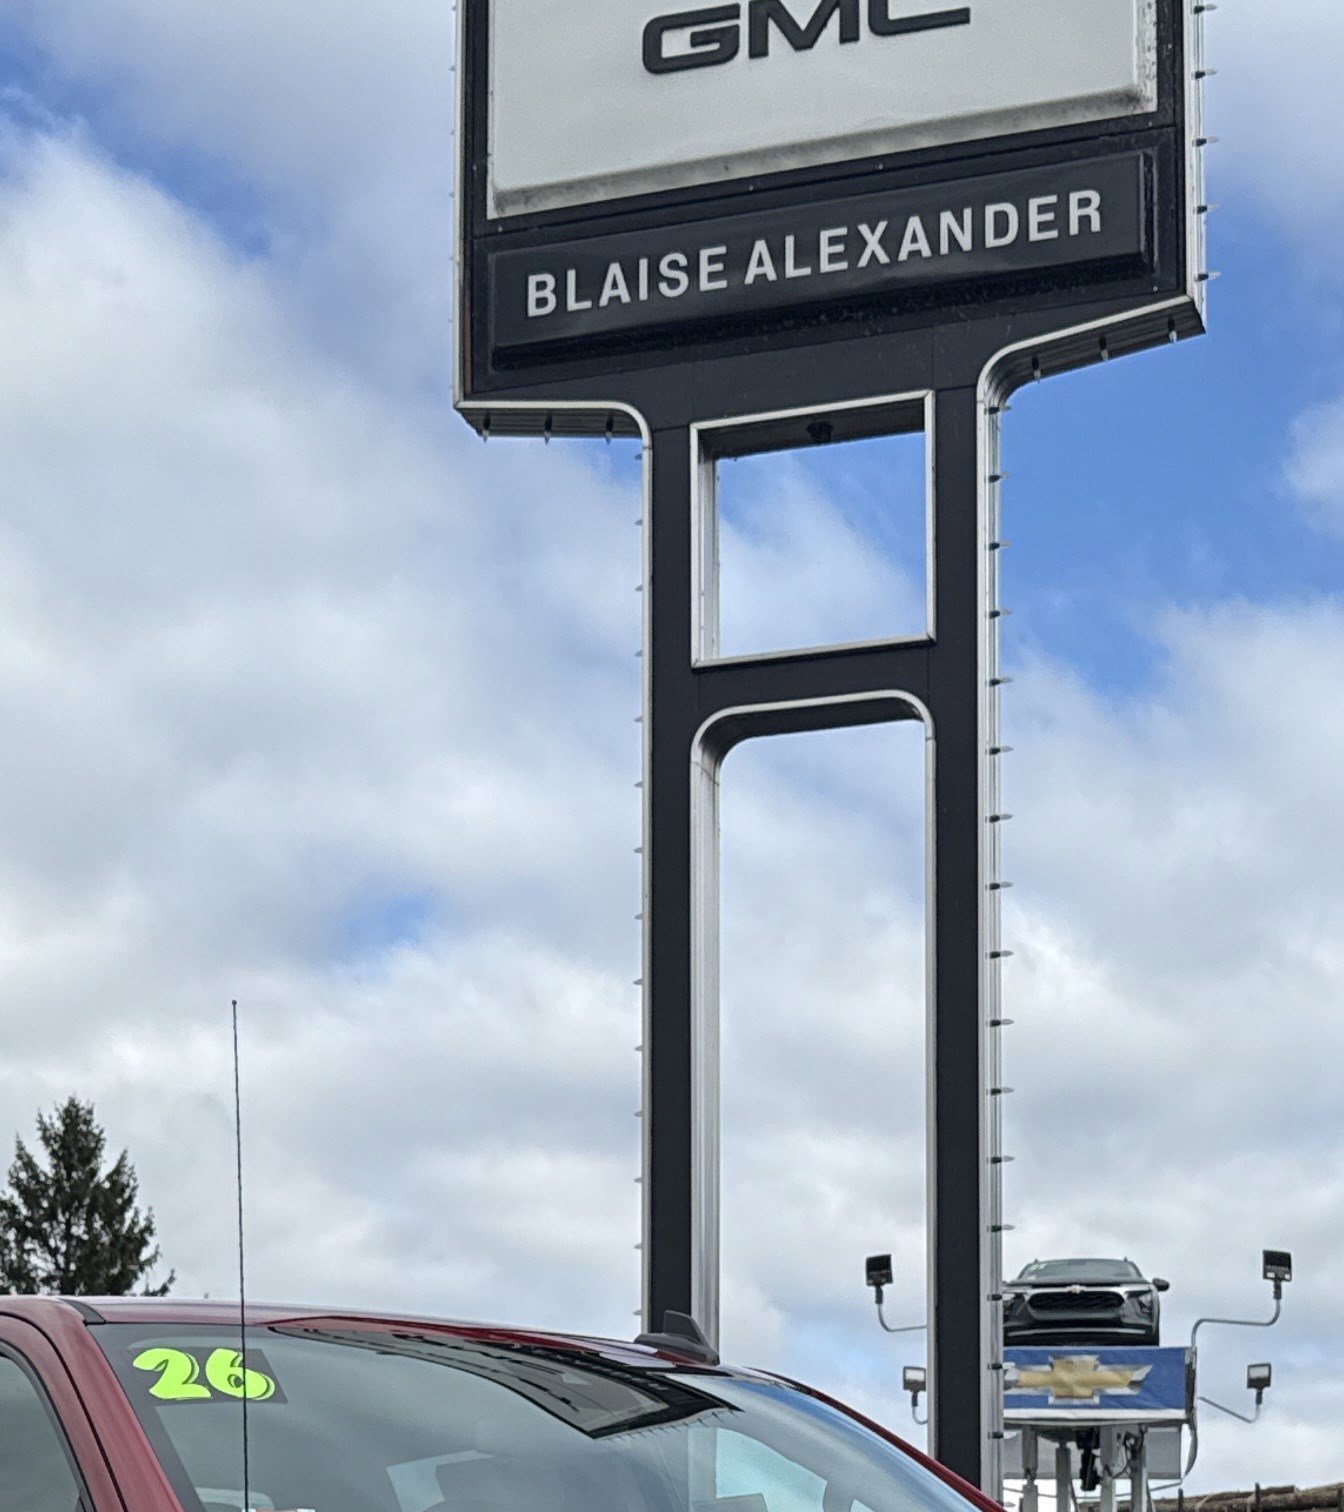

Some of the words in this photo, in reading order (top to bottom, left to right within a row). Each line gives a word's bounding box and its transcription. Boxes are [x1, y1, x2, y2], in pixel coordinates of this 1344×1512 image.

[525, 245, 729, 319] BLAISE
[744, 189, 1103, 286] ALEXANDER
[133, 1348, 276, 1400] 26
